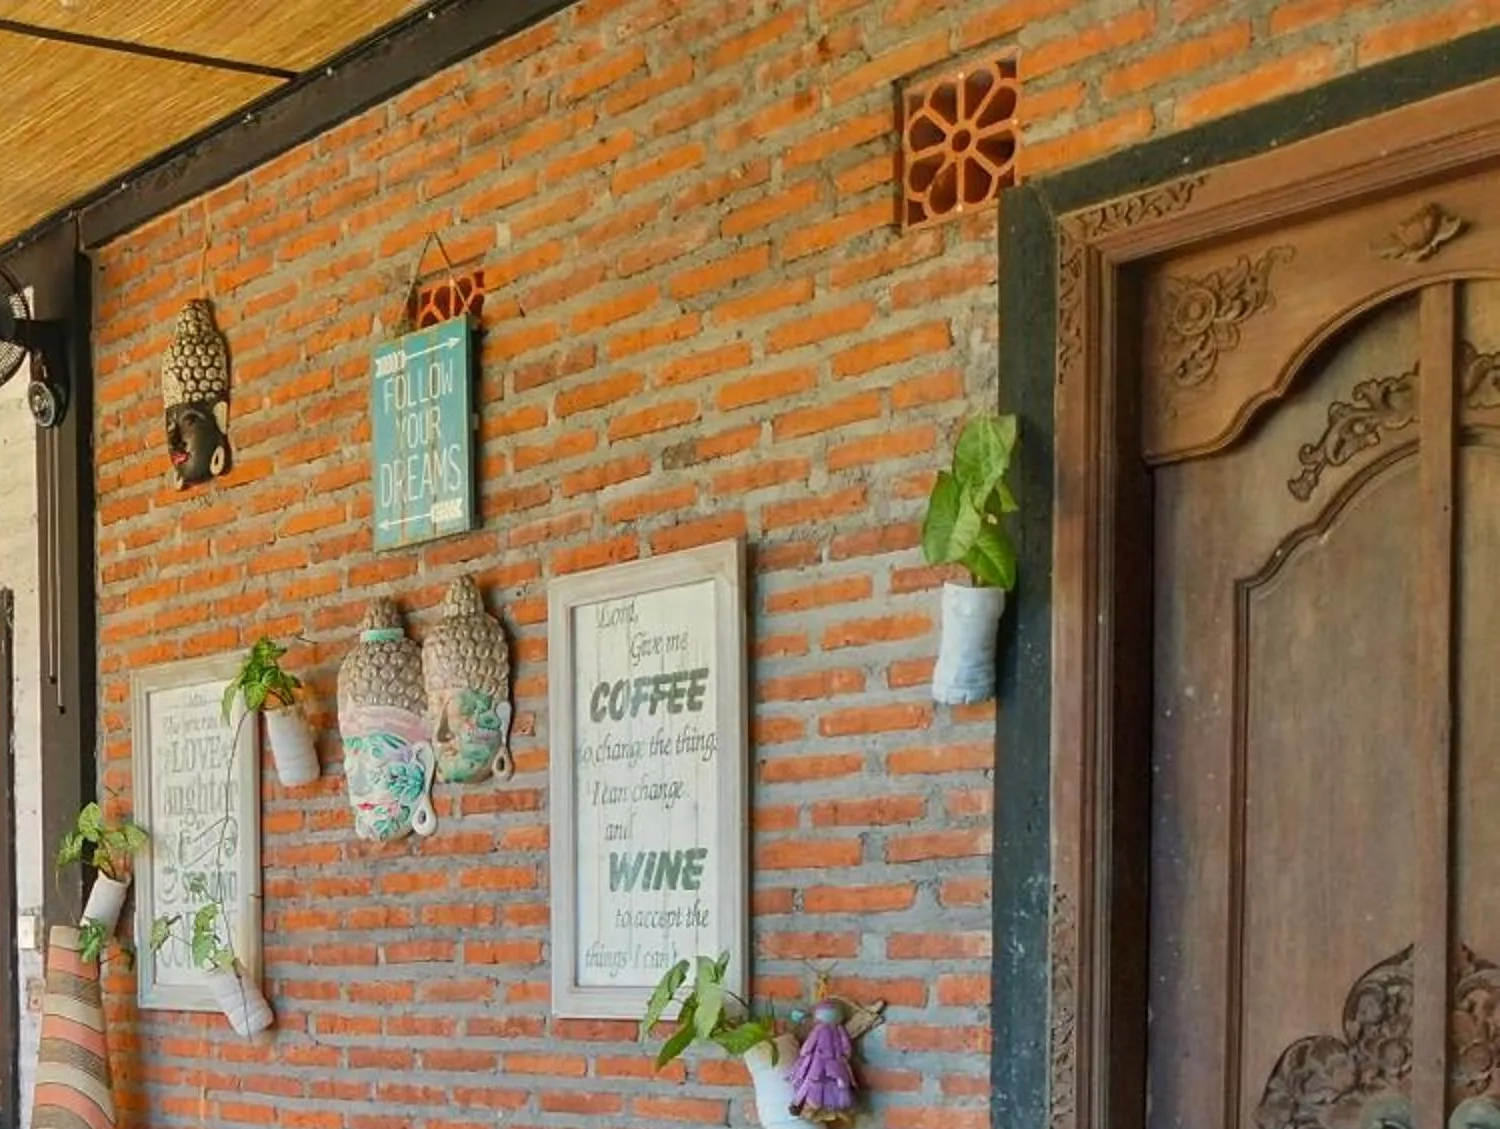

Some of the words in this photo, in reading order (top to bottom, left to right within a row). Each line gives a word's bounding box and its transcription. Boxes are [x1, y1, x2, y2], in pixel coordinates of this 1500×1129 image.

[383, 358, 453, 415] FOLLOW
[395, 405, 441, 450] YOUR
[381, 444, 461, 508] DREAMS
[665, 631, 689, 653] me
[590, 667, 710, 723] COFFEE
[171, 735, 221, 773] LOVE
[596, 732, 647, 768] change
[649, 727, 672, 757] the
[609, 847, 709, 892] WINE
[615, 908, 632, 929] to
[685, 898, 709, 929] the
[585, 940, 628, 978] things
